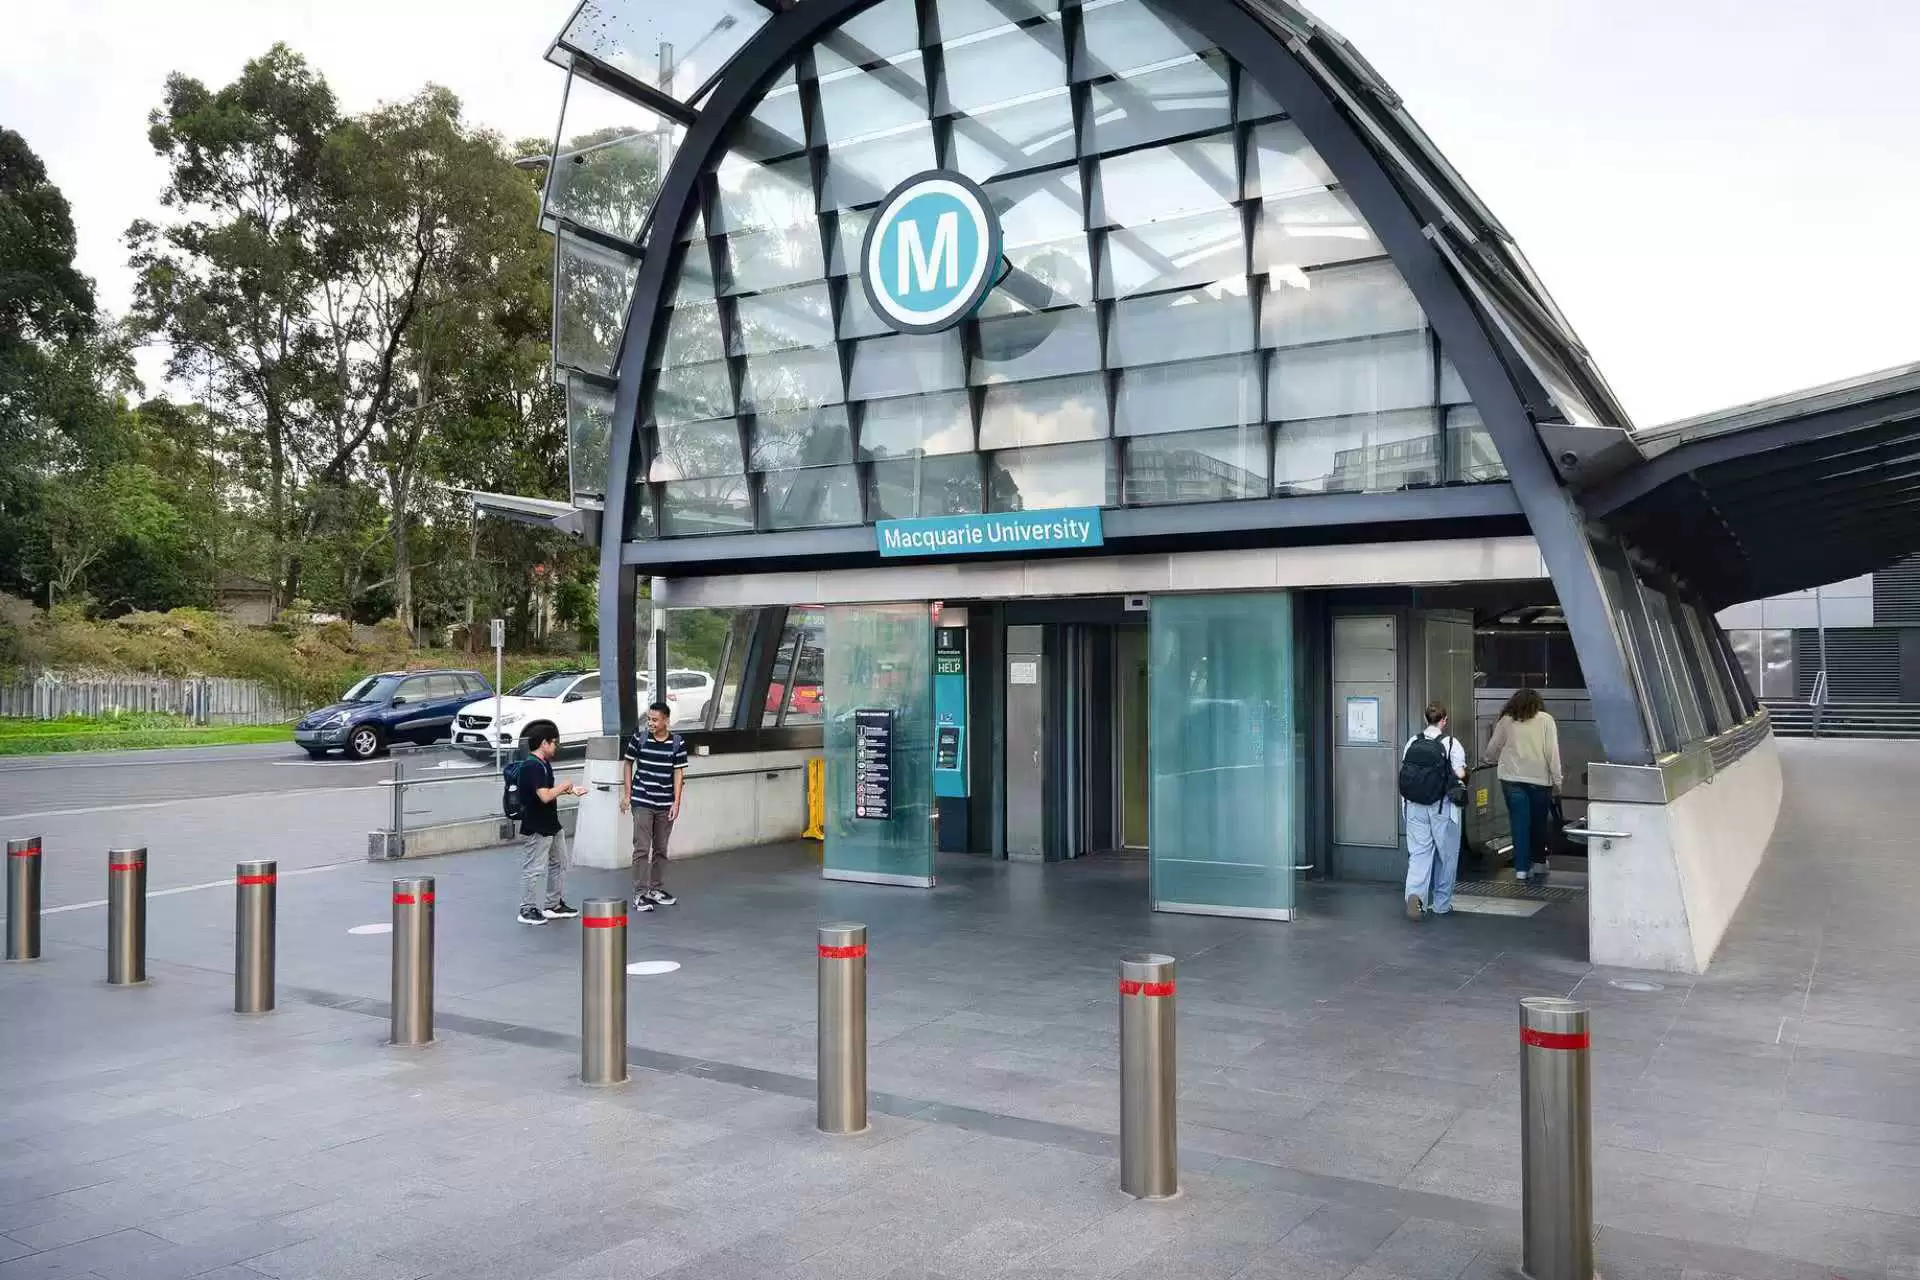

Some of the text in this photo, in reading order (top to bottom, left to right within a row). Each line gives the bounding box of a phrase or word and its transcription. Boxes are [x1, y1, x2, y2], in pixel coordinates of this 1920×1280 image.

[897, 211, 958, 296] M
[885, 518, 1090, 550] Macquarie University
[938, 663, 961, 673] HELP
